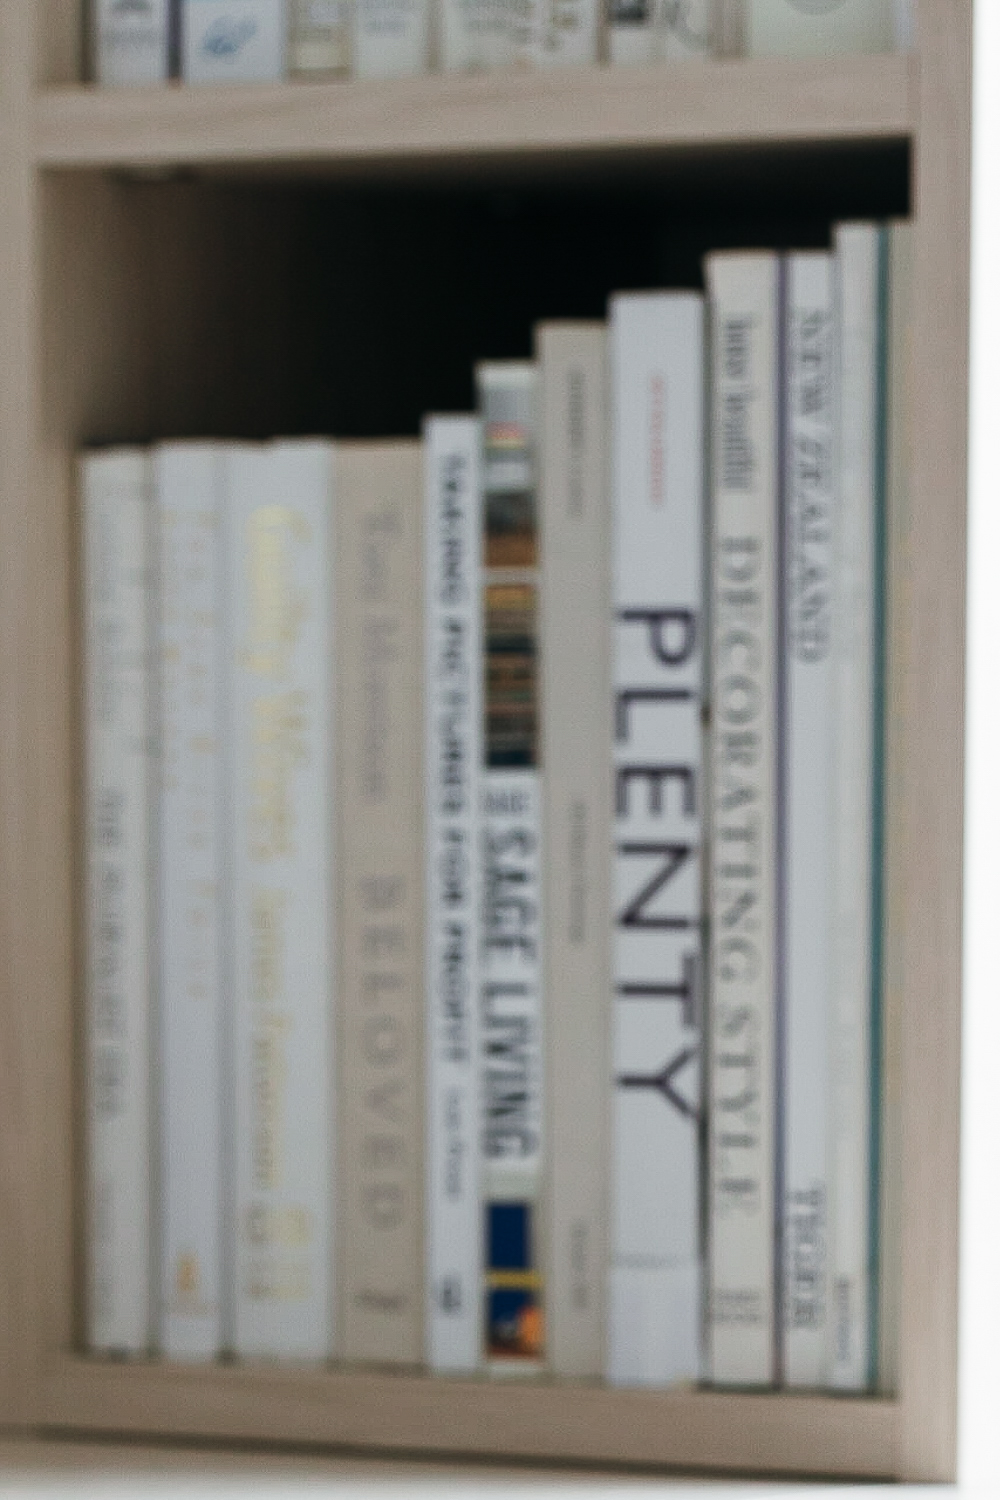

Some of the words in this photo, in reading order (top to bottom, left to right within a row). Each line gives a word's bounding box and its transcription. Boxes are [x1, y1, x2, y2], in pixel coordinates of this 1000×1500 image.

[796, 308, 833, 416] NEW
[442, 455, 471, 605] TAKING
[795, 434, 833, 663] ZEALAND
[442, 616, 471, 816] PICTURES
[716, 536, 763, 983] DECORATING
[442, 827, 471, 906] FOR
[483, 822, 539, 962] SAGE
[615, 608, 701, 1121] PLENTY
[361, 875, 408, 1231] BELOVED
[442, 921, 471, 1064] PROFIT
[483, 979, 538, 1160] LIVING
[716, 1005, 760, 1216] STYLE
[787, 1181, 830, 1332] TIGER
